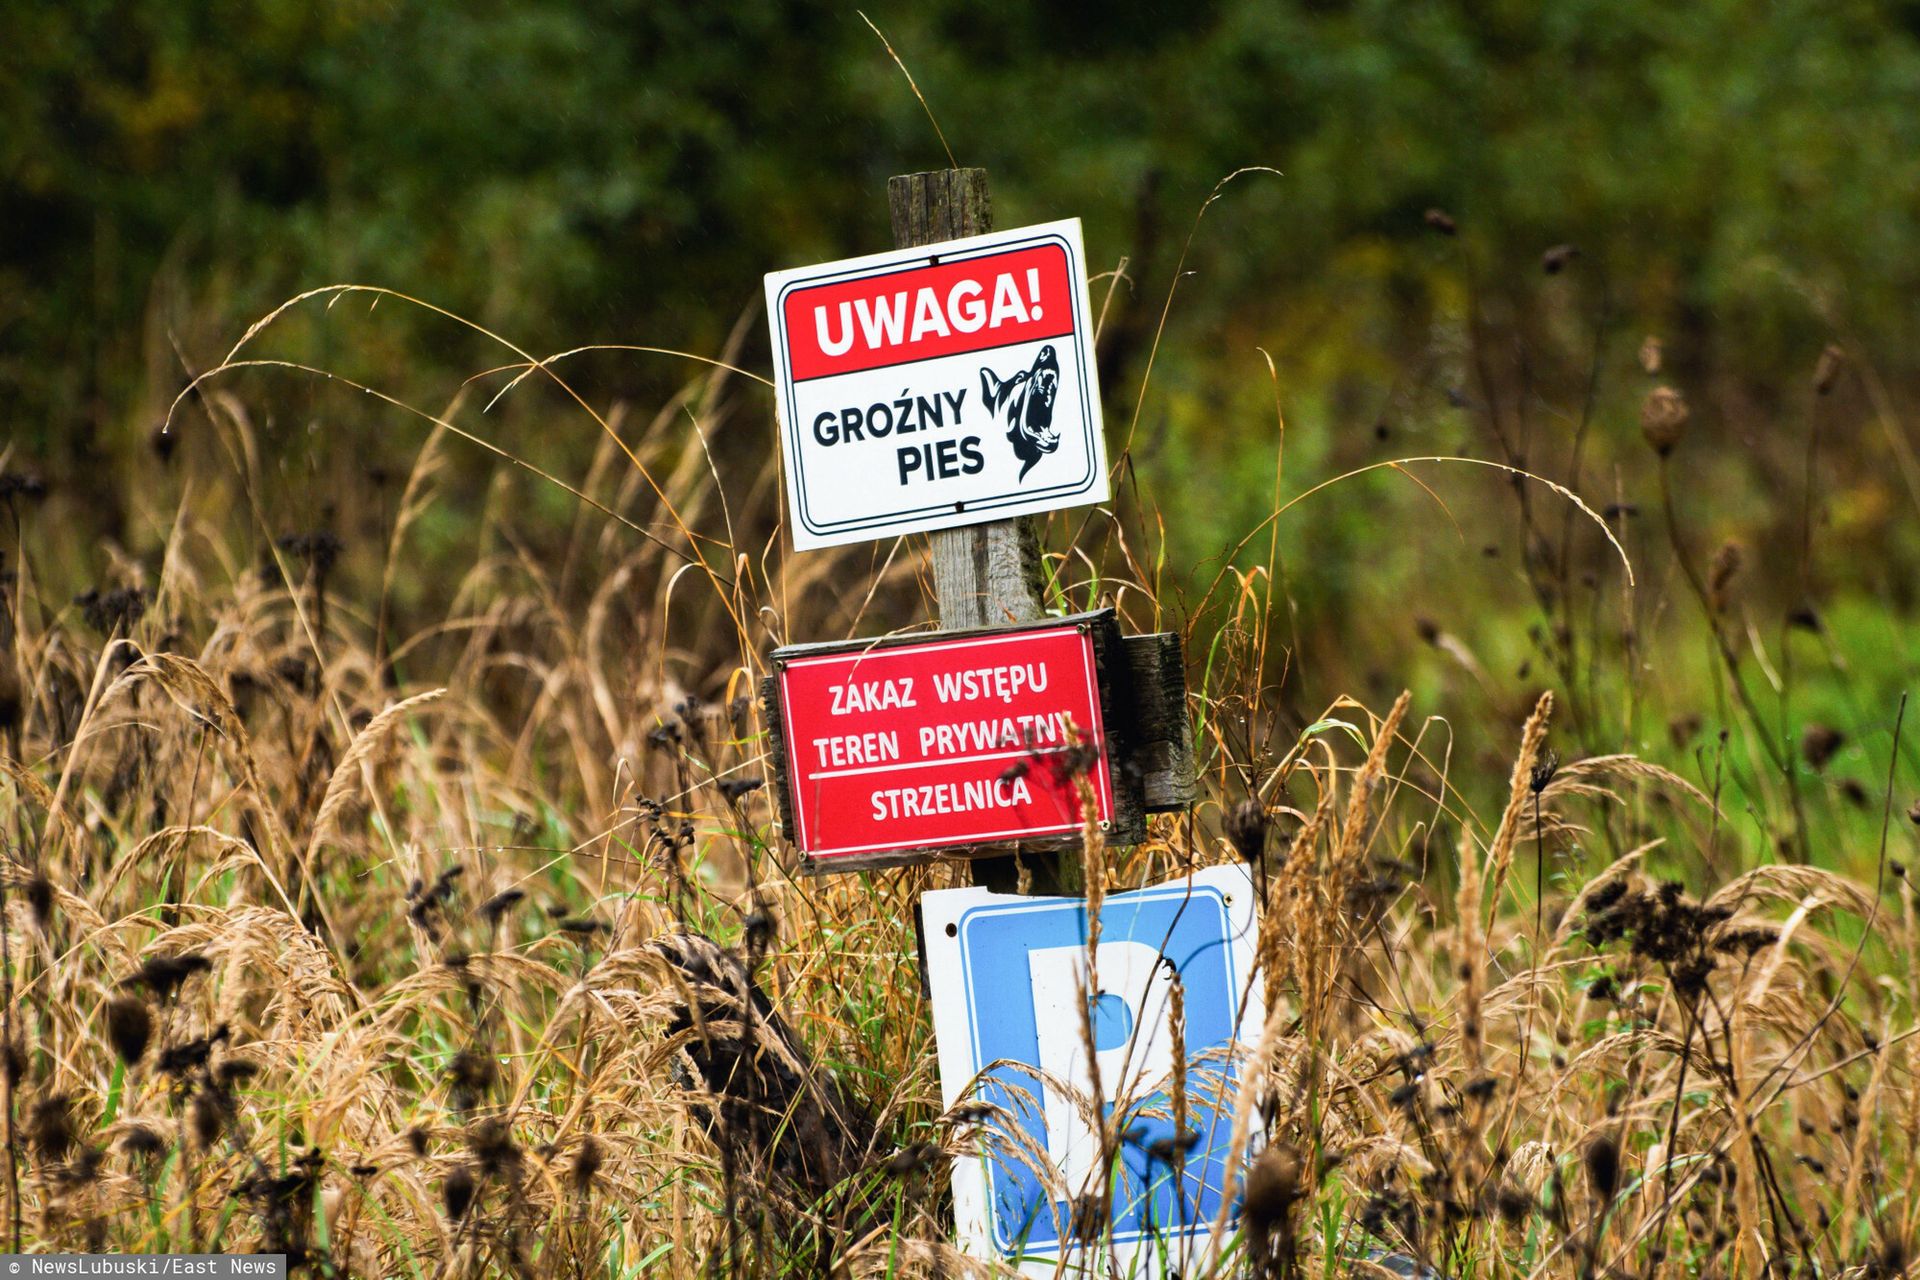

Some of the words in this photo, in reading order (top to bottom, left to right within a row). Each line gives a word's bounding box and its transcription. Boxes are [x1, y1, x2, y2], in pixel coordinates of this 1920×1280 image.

[814, 267, 1043, 356] UWAGA!
[813, 388, 967, 446] GROŹNY
[897, 436, 984, 485] PIES
[829, 677, 917, 715] ZAKAZ
[933, 662, 1048, 703] WSTĘPU
[813, 730, 900, 768] TEREN
[871, 776, 1032, 821] STRZELNICA
[1028, 942, 1187, 1202] P
